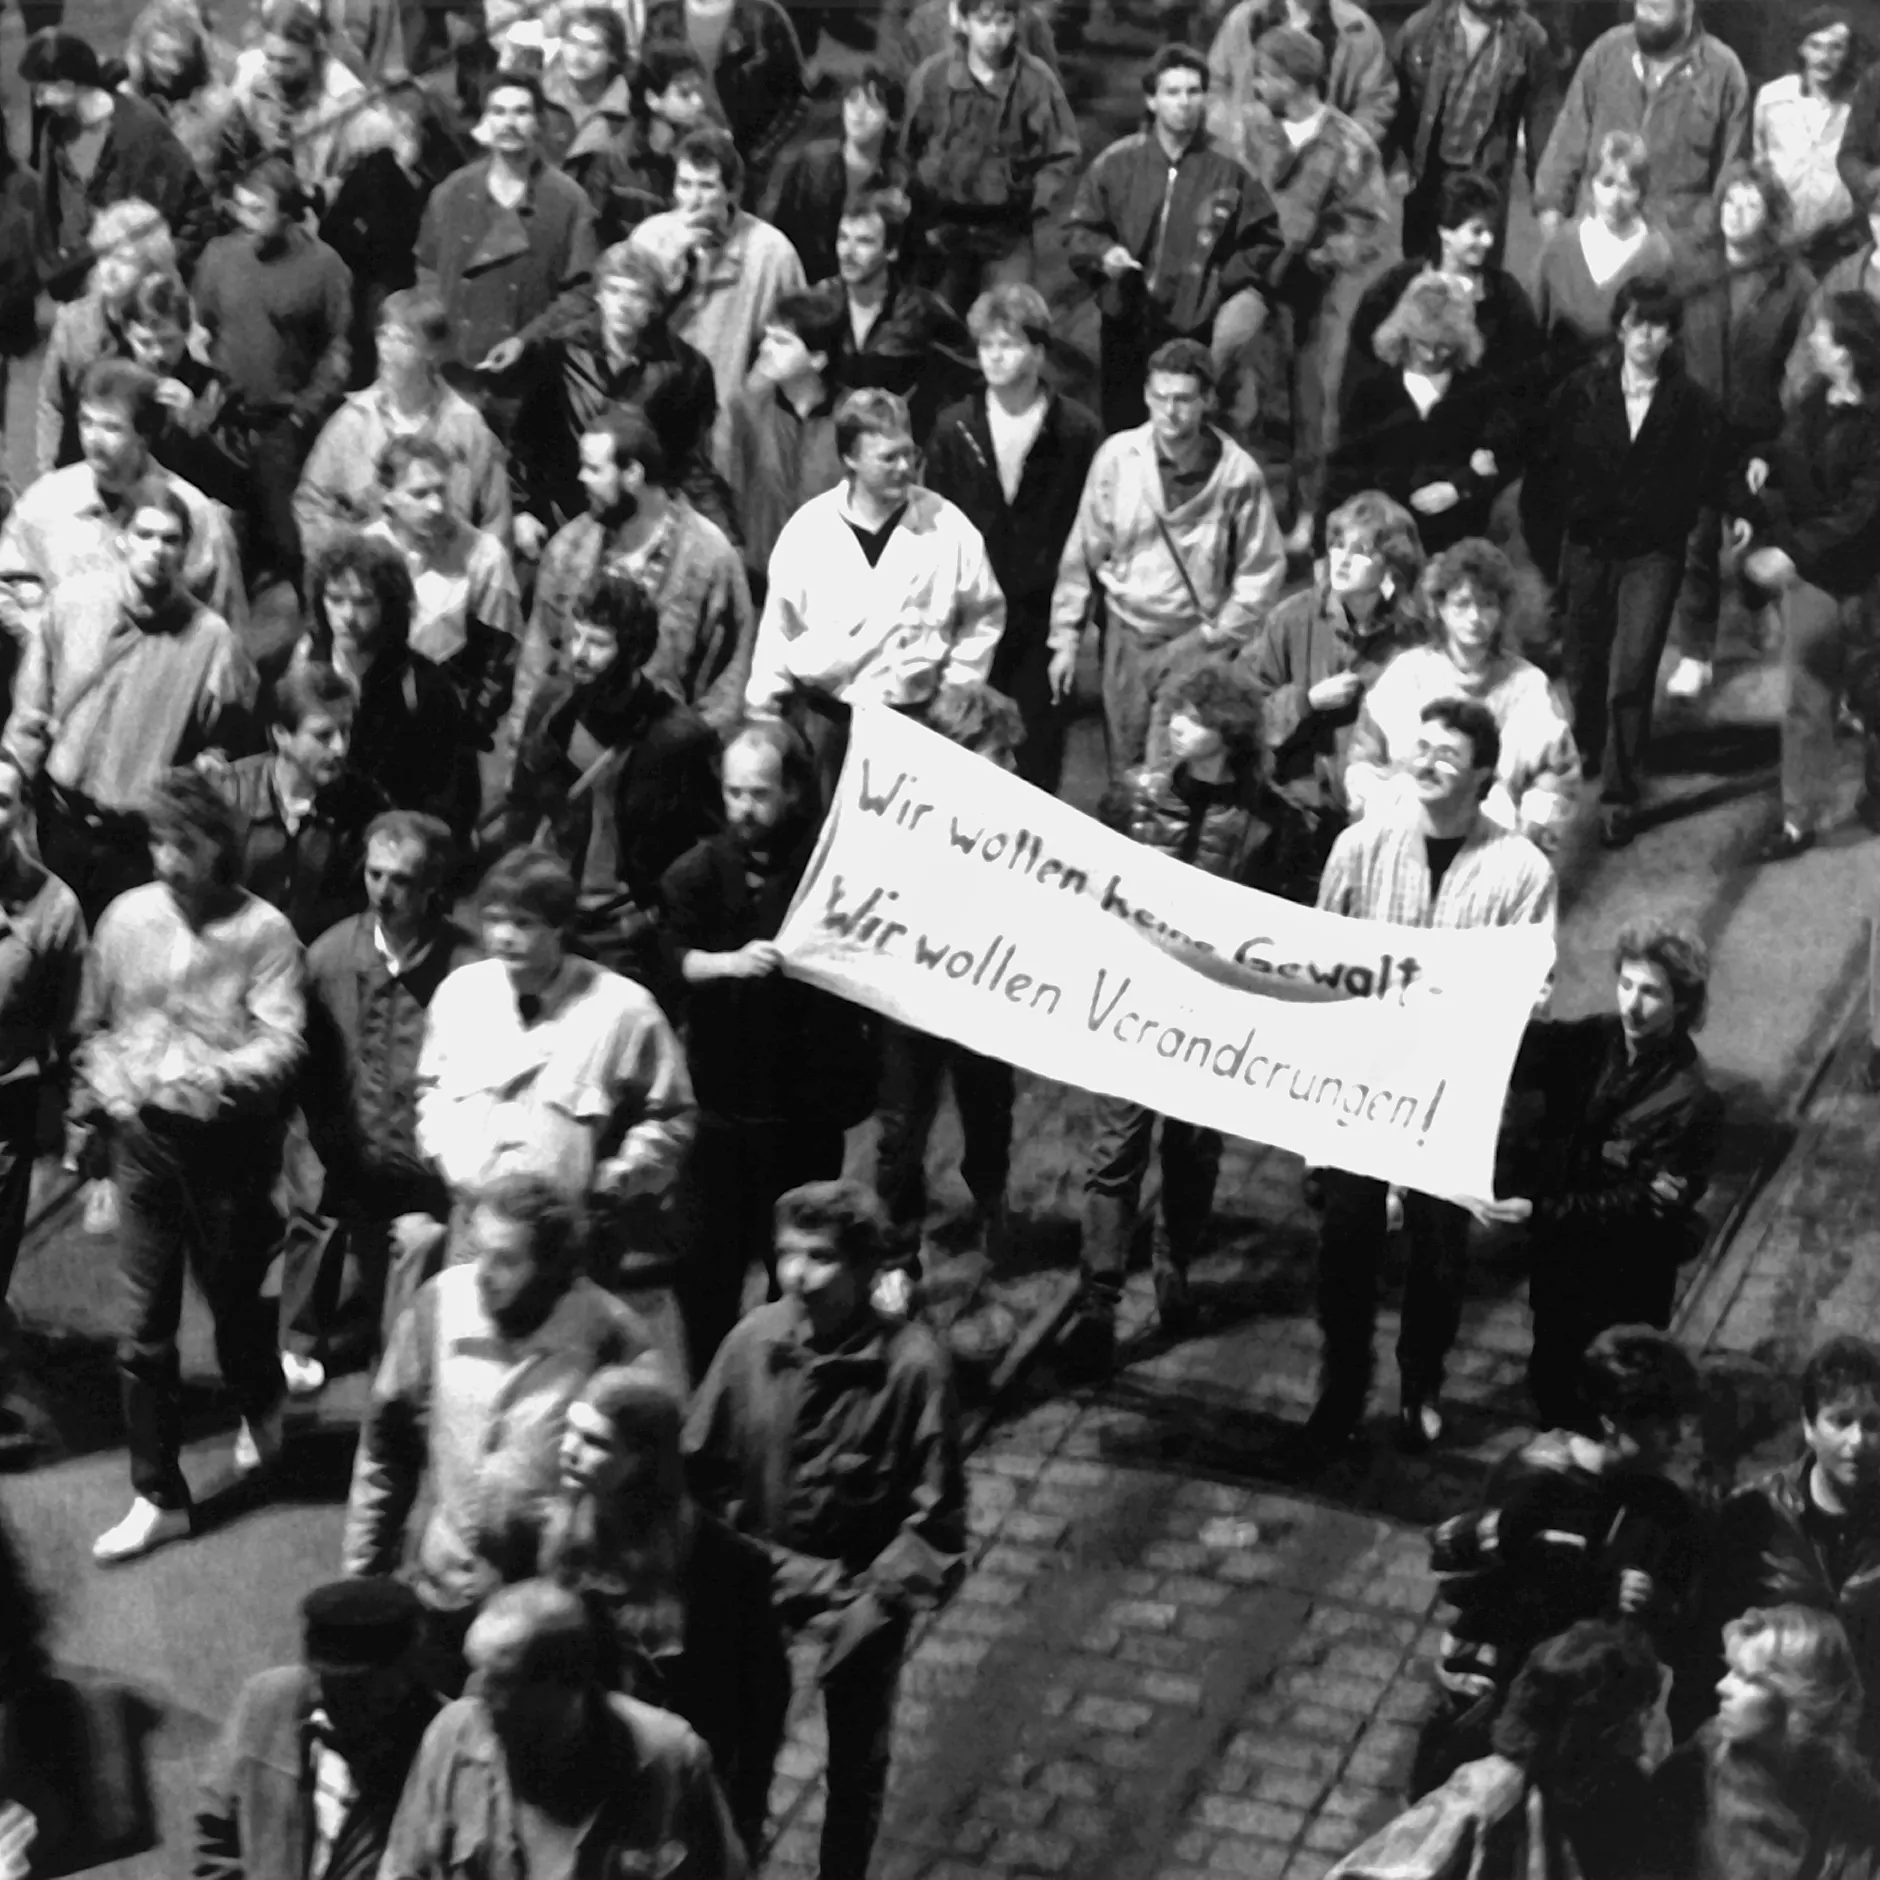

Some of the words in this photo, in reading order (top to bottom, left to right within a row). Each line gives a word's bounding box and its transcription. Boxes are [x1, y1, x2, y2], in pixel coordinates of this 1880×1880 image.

[858, 758, 935, 831] Wir
[950, 816, 1088, 895] wollen
[822, 874, 908, 949] Wir
[914, 934, 1061, 1014] wollen
